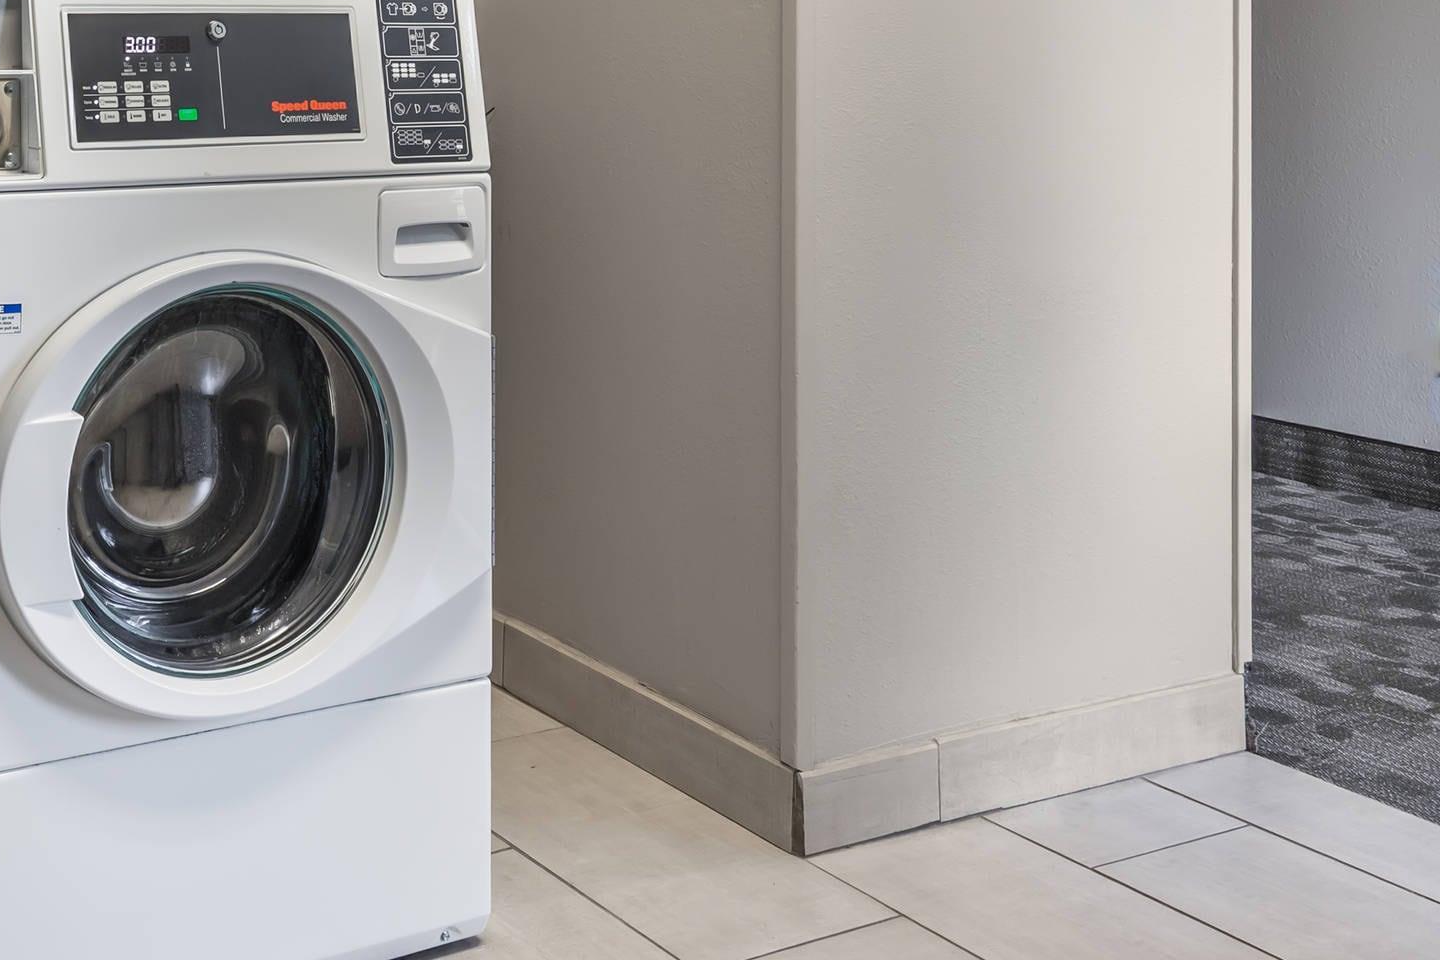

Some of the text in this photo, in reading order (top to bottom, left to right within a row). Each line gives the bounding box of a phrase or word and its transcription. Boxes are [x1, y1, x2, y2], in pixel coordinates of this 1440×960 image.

[125, 37, 156, 53] 3.00
[271, 100, 347, 113] Speed Queen
[280, 112, 348, 123] Commercial Washer
